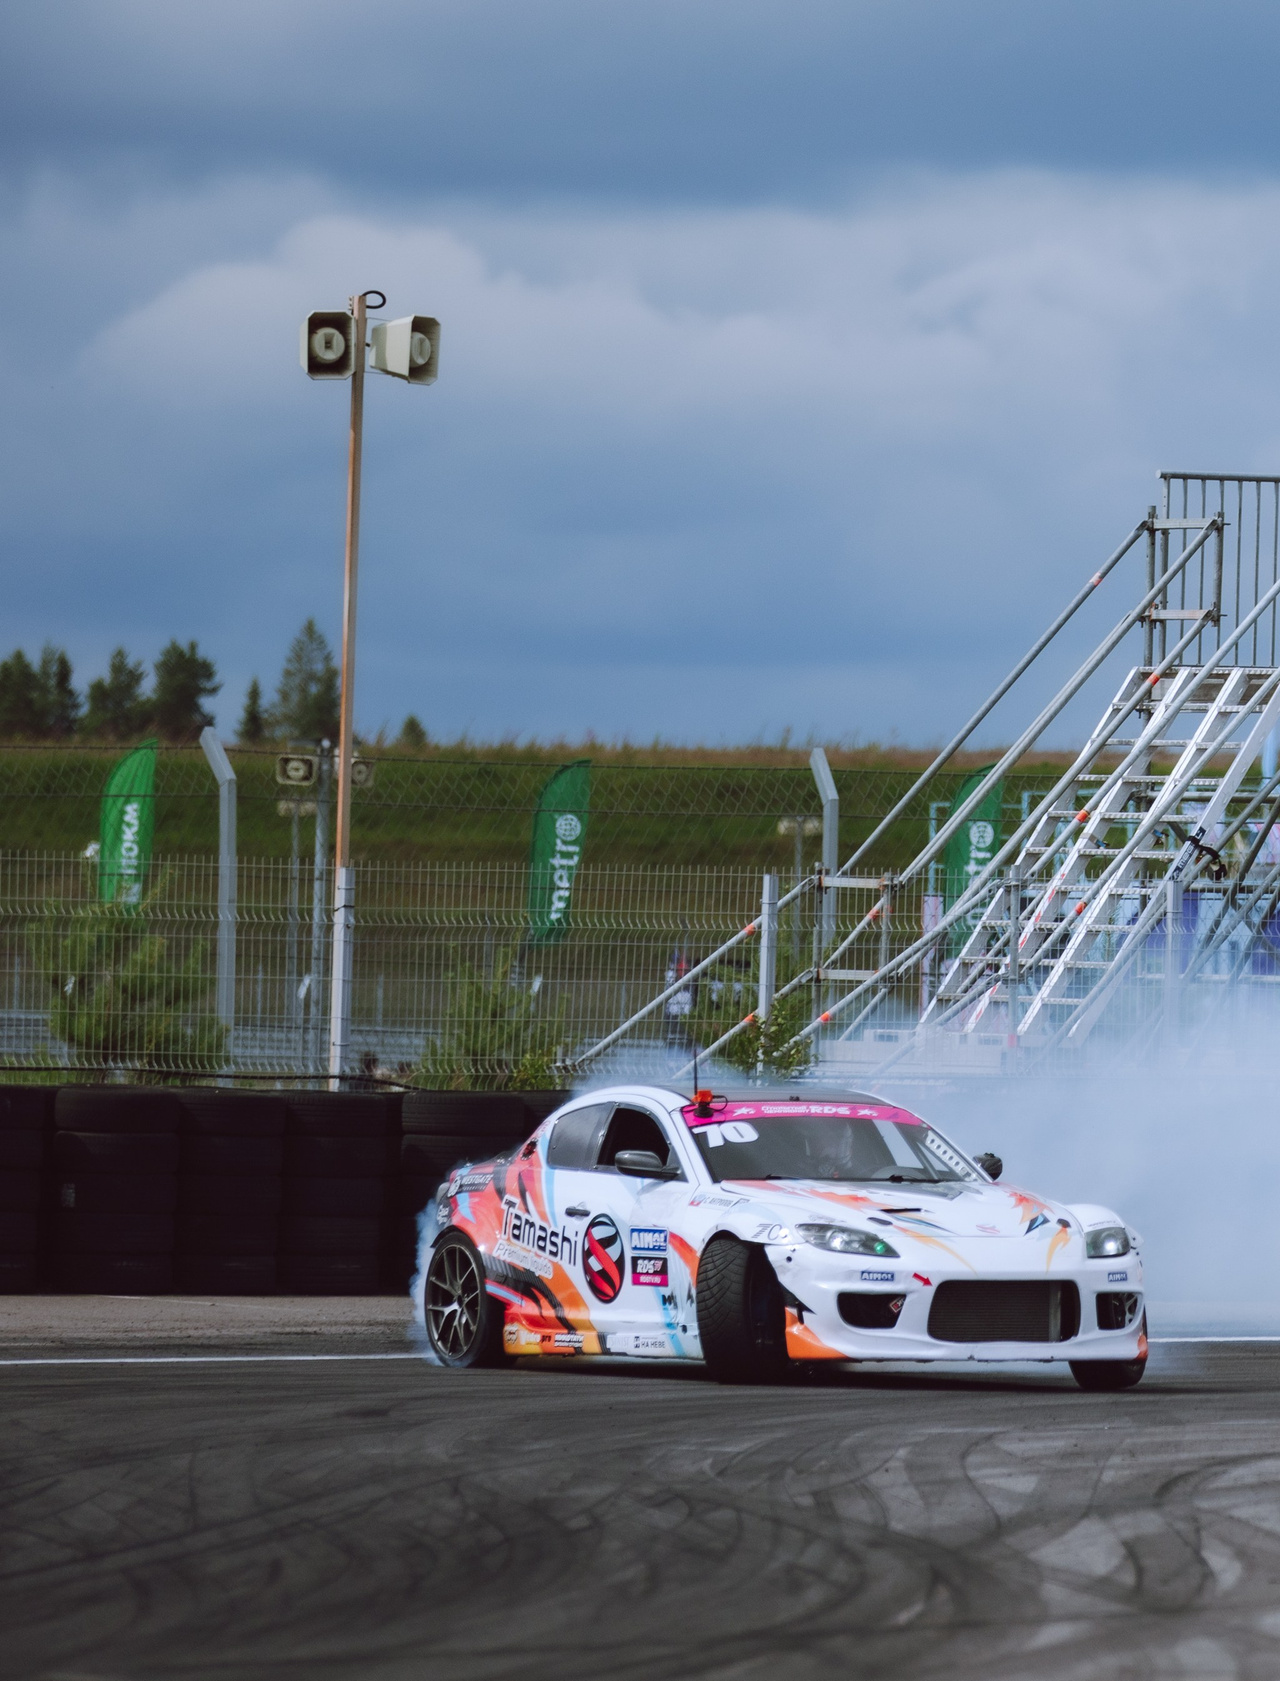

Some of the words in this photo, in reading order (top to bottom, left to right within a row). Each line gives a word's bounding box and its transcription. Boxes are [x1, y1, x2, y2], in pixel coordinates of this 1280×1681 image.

[809, 1105, 851, 1115] RDS
[692, 1121, 760, 1148] 70
[503, 1198, 579, 1267] Tamashi
[631, 1231, 667, 1250] AIMOL
[862, 1272, 892, 1280] AIMOL
